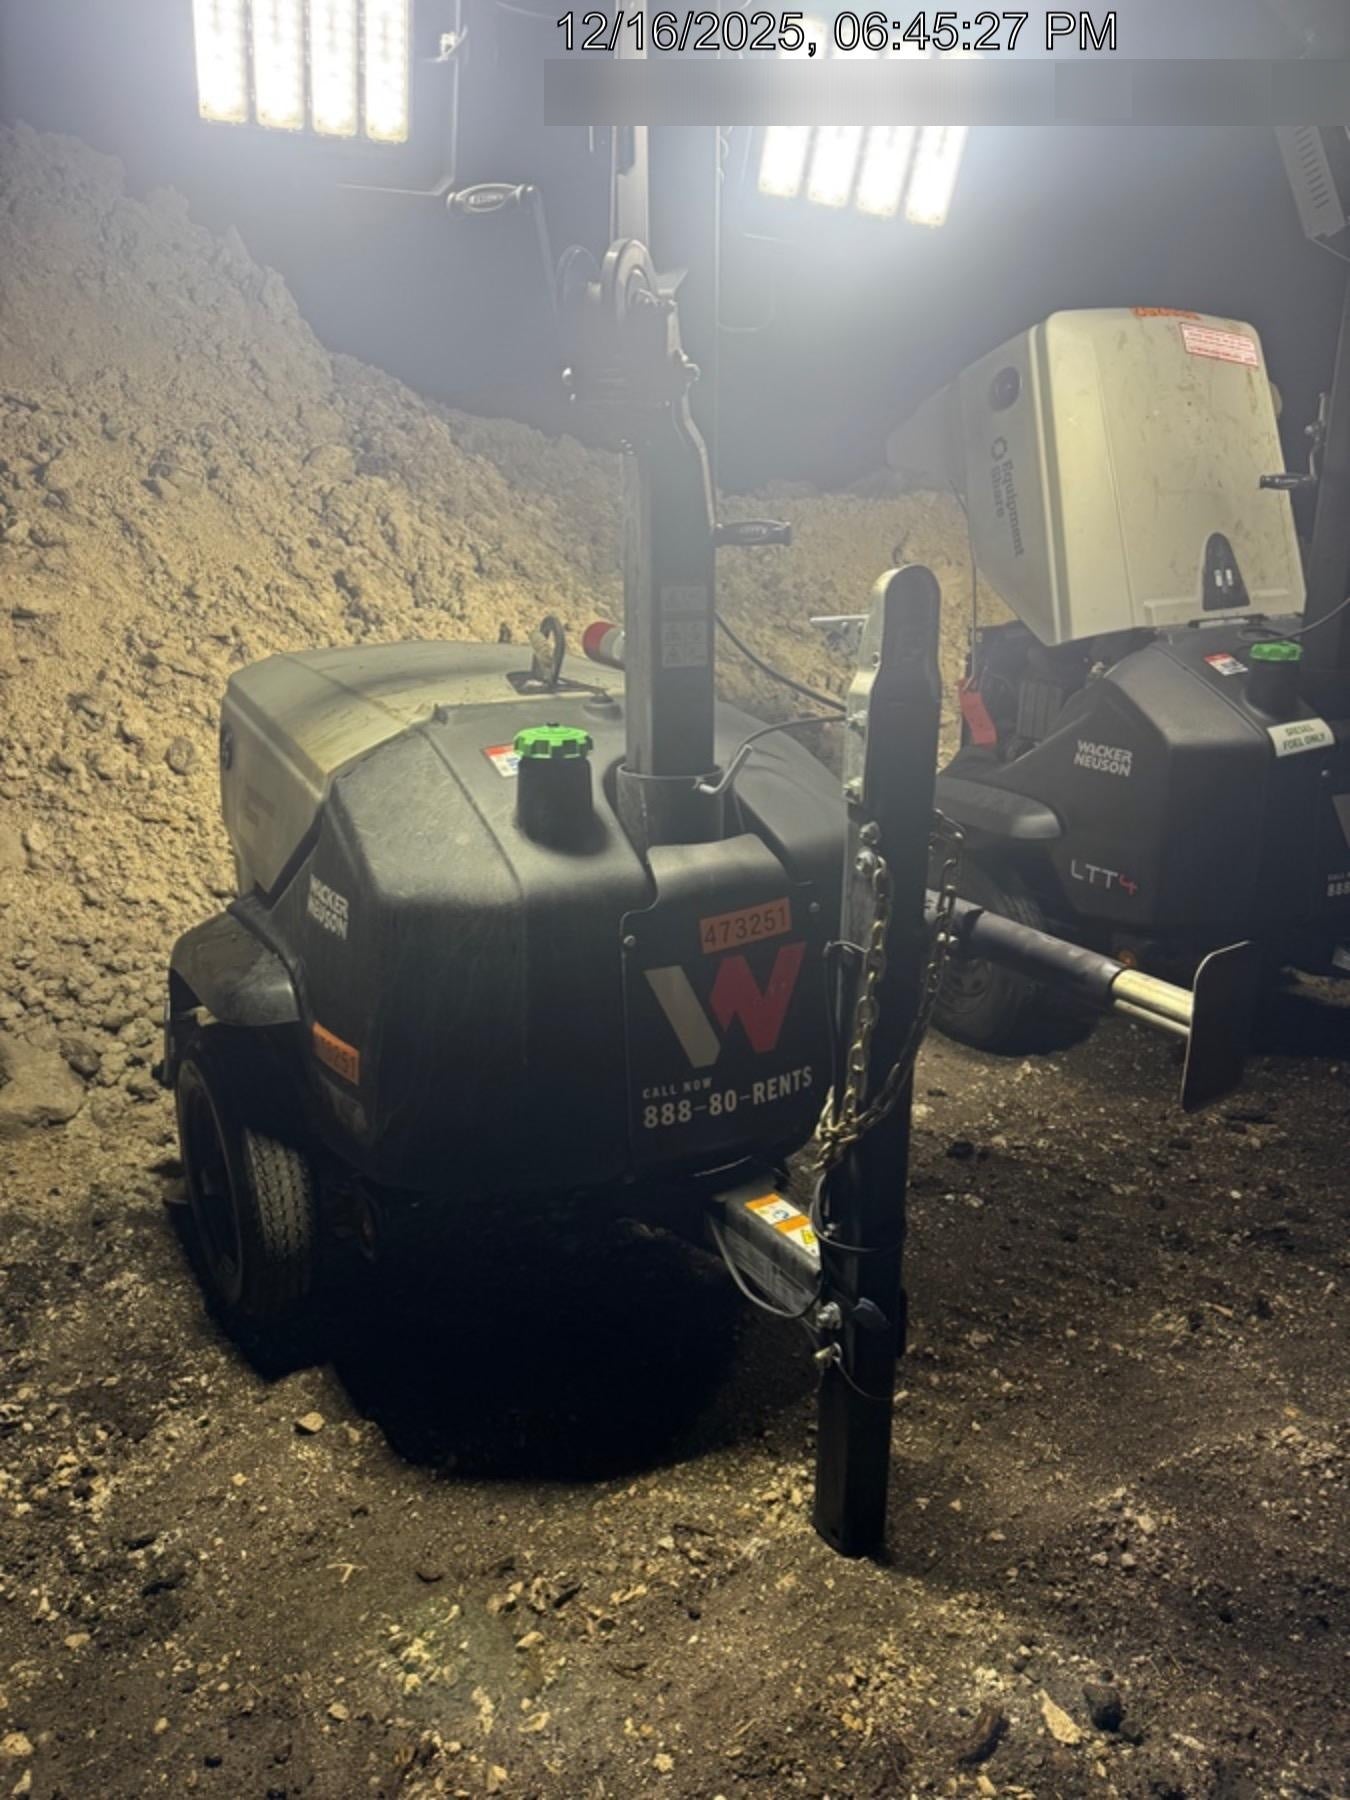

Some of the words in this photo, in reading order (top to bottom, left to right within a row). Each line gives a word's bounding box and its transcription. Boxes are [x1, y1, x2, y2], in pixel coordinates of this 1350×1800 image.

[1073, 752, 1132, 777] NEUSON
[1077, 739, 1133, 762] WACKER
[1070, 859, 1138, 896] LTT4
[703, 905, 787, 947] 473251
[642, 1084, 679, 1099] CALL
[683, 1076, 713, 1092] NOW
[643, 1065, 814, 1128] 888-80-RENTS
